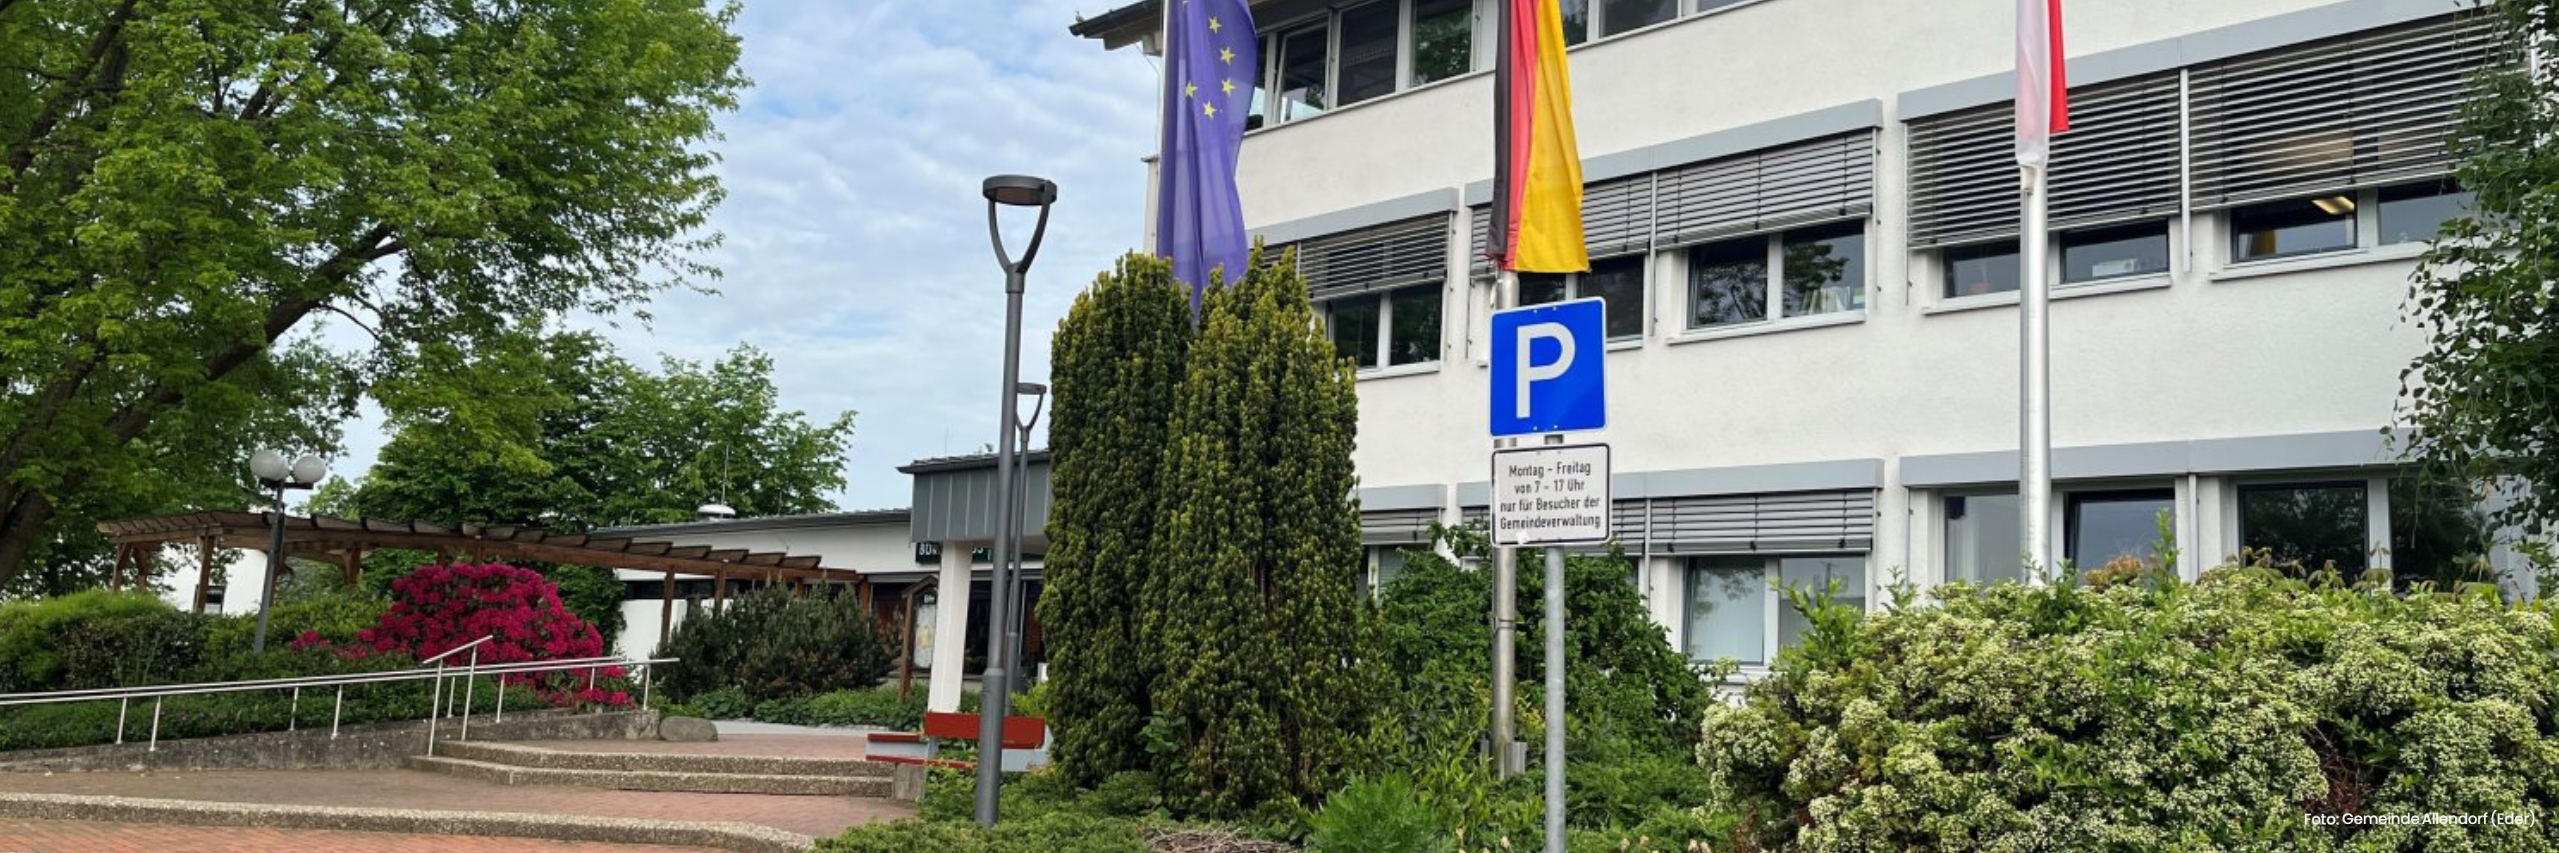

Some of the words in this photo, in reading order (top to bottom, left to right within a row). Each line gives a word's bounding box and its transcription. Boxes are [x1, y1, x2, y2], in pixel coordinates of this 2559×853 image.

[1516, 322, 1576, 419] P
[1509, 464, 1545, 479] Montag
[1556, 461, 1591, 476] Freitag
[1514, 484, 1532, 494] von
[1534, 480, 1541, 493] 7
[1554, 479, 1565, 492] 17
[1567, 479, 1585, 491] Uhr
[1500, 502, 1516, 512] nur
[1519, 499, 1533, 511] für
[1536, 496, 1581, 511] Besucher
[1584, 496, 1600, 508] der
[1500, 514, 1601, 529] Gemeindeverwaltung
